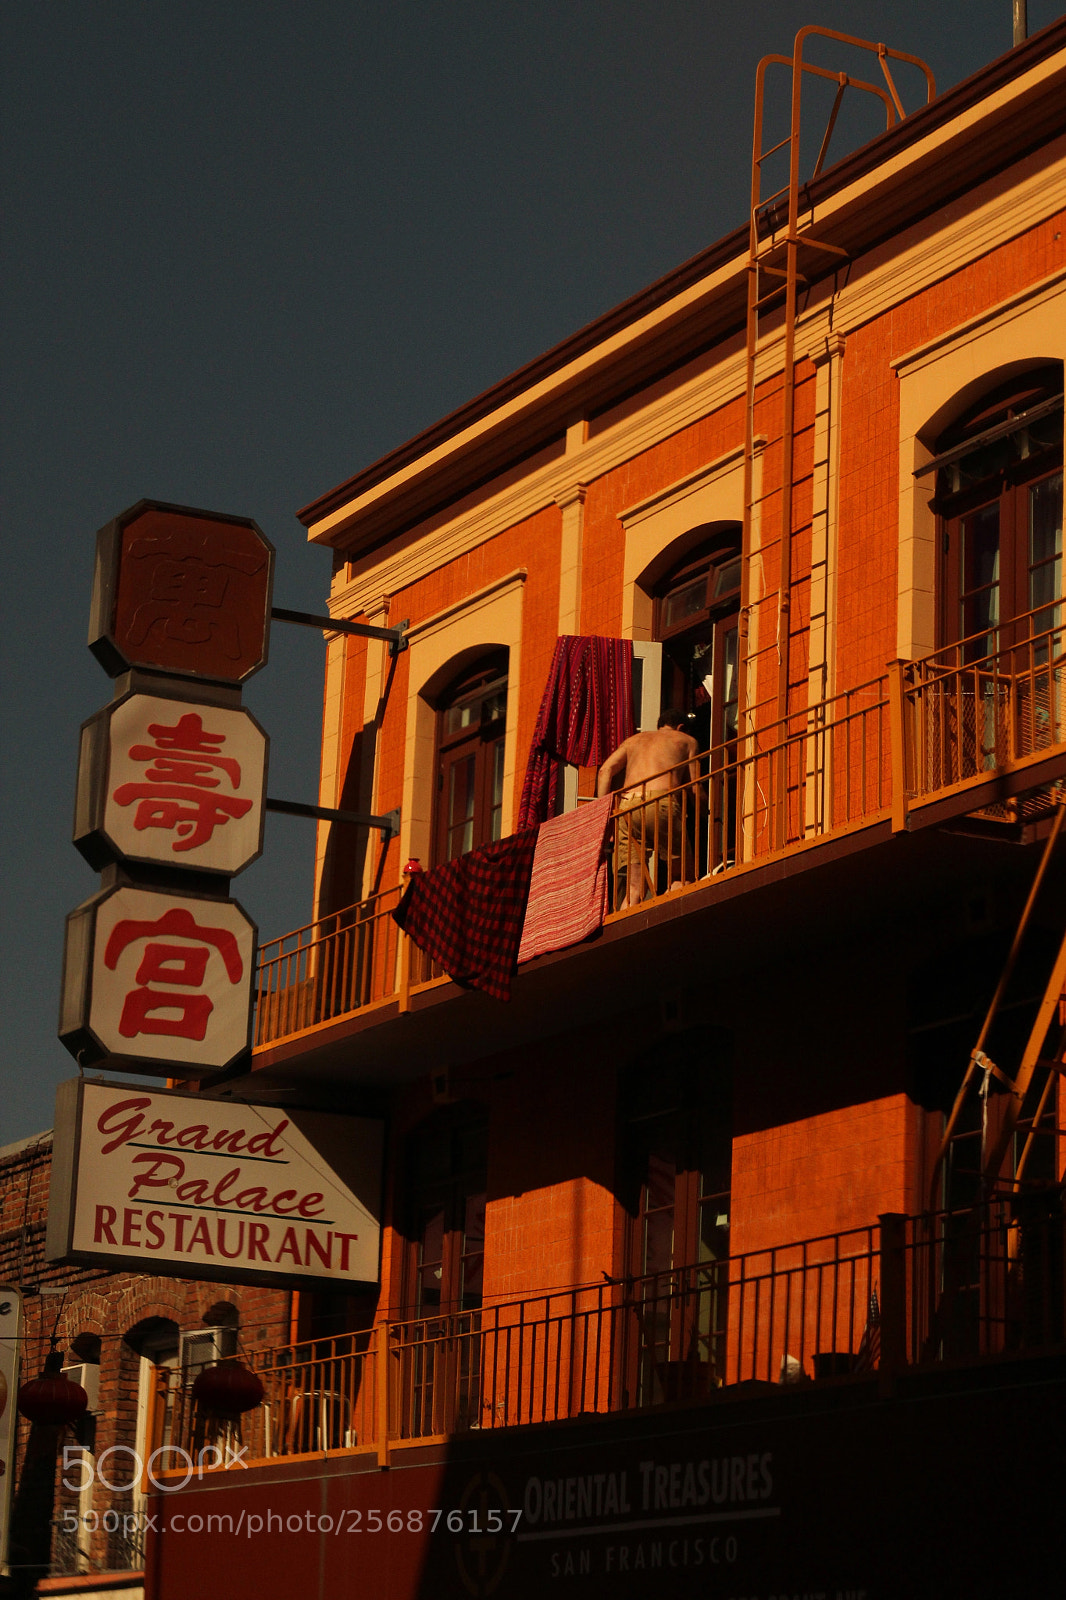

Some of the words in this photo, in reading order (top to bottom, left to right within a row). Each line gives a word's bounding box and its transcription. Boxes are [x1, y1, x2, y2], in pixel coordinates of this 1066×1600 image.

[97, 1097, 289, 1156] Grand
[127, 1152, 325, 1218] Palace
[93, 1203, 358, 1271] RESTAURANT
[523, 1471, 632, 1525] ORIENTAL
[639, 1452, 775, 1511] TREASURES
[551, 1549, 591, 1578] SAN
[604, 1535, 739, 1573] FRANCISCO
